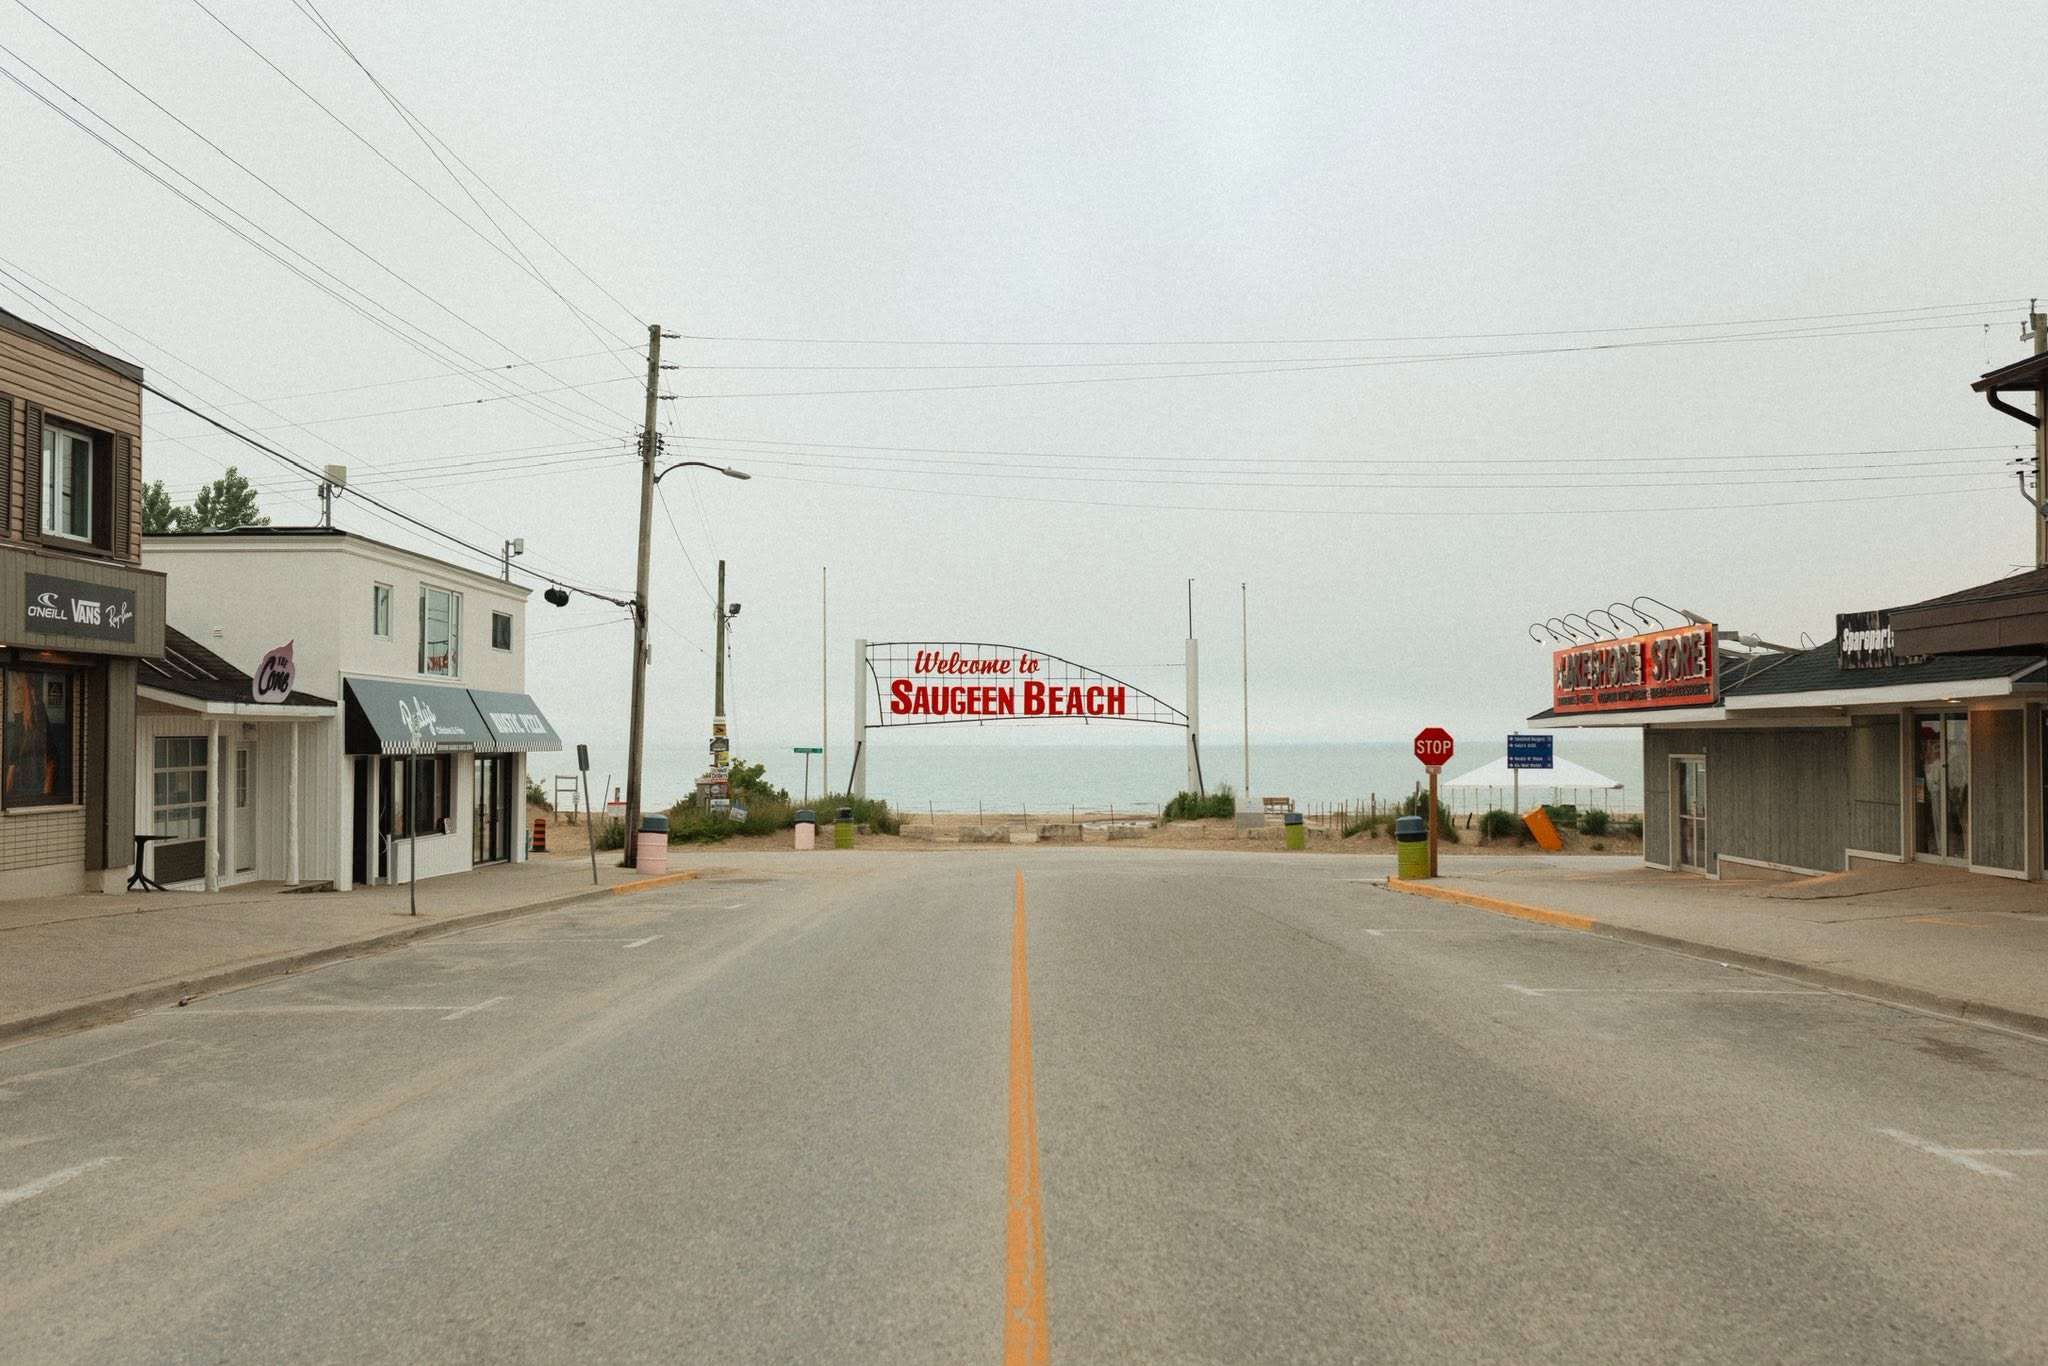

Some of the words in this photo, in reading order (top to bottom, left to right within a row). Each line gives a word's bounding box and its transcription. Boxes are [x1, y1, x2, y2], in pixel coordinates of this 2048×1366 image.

[71, 598, 101, 626] VANS
[914, 650, 1012, 674] Welcome
[1018, 650, 1040, 674] to
[1557, 642, 1643, 692] LAKESHORE
[1652, 631, 1706, 684] STORE
[891, 679, 1015, 716] SAUGEEN
[1023, 680, 1126, 717] BEACH
[489, 712, 526, 734] RUSTIC
[517, 713, 547, 734] PIZZA
[1416, 740, 1452, 755] STOP
